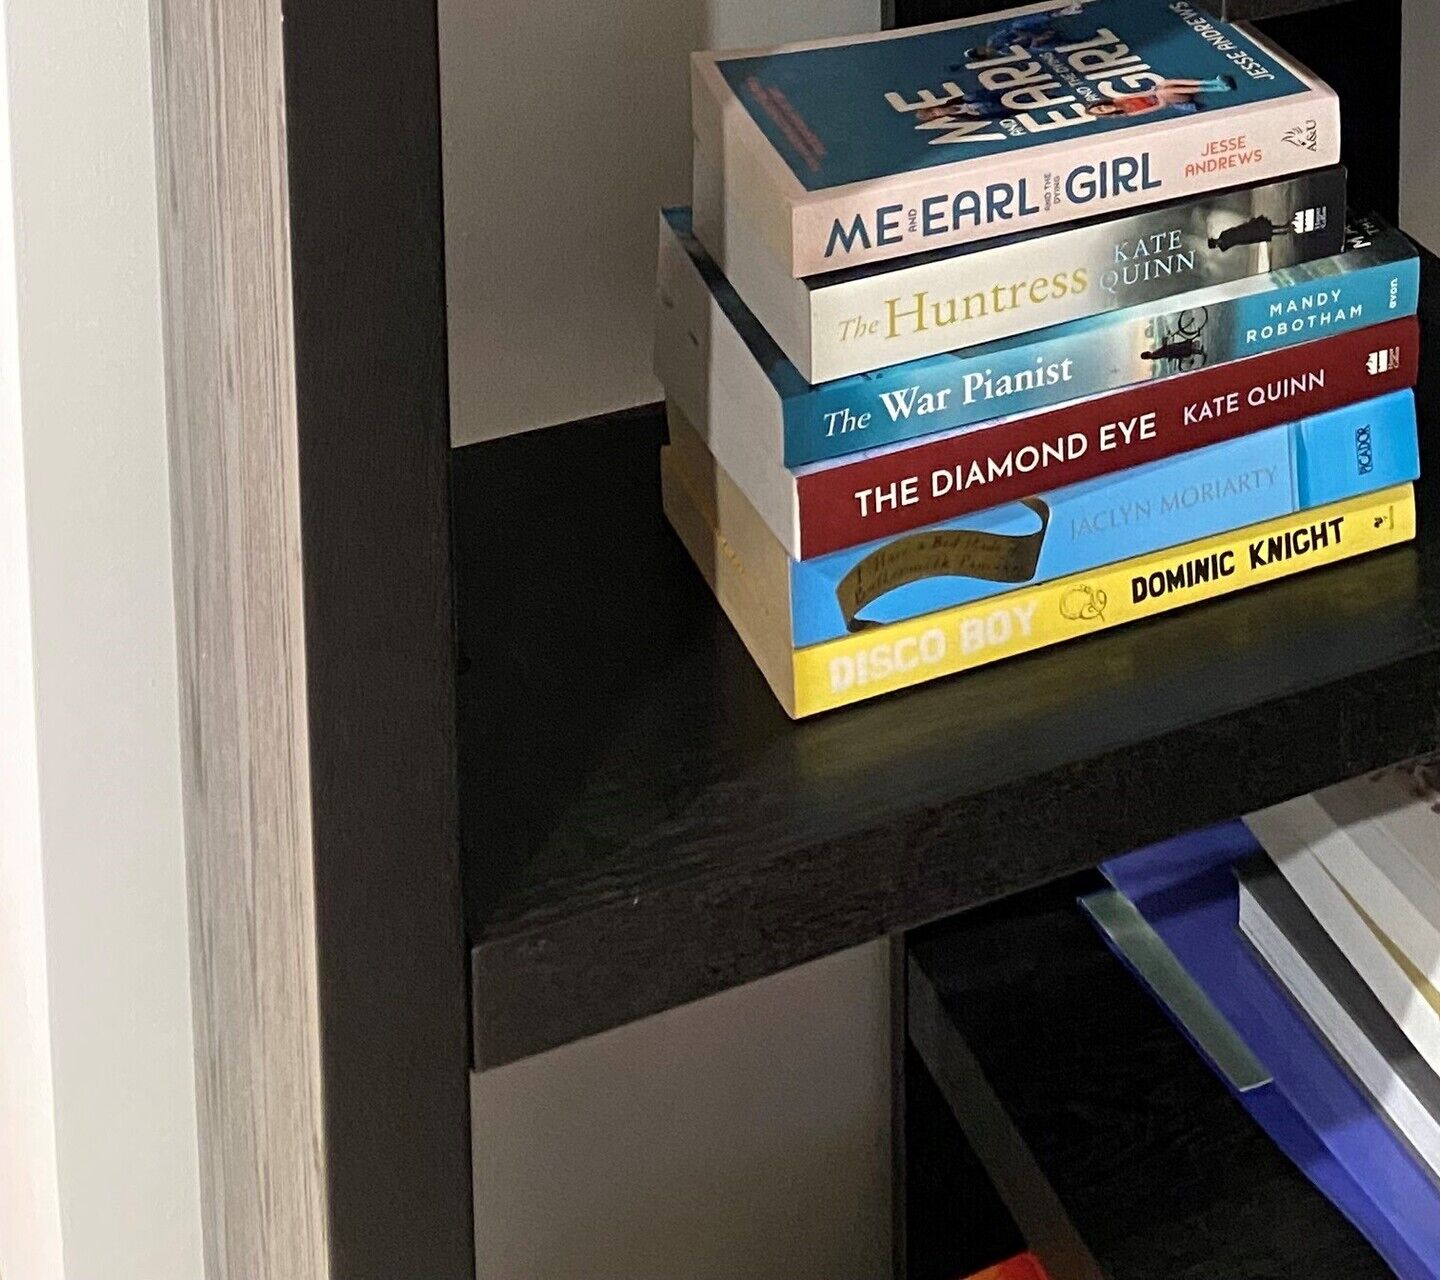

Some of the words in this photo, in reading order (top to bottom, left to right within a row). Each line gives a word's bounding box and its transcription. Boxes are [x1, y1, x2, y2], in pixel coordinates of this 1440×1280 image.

[1168, 0, 1237, 51] ANDREWS
[964, 44, 1097, 132] EARL
[1055, 28, 1165, 99] GIRL
[1225, 48, 1275, 80] JESSE
[884, 81, 1007, 146] ME
[1306, 119, 1317, 152] A&U
[1184, 149, 1264, 178] ANDREWS
[1199, 135, 1247, 158] JESSE
[1053, 175, 1061, 204] DYING
[1065, 152, 1162, 205] GIRL
[824, 203, 904, 258] ME
[907, 206, 918, 233] AND
[921, 175, 1040, 238] EARL
[1100, 249, 1197, 296] QUINN
[1113, 230, 1183, 264] KATE
[838, 315, 879, 343] The
[883, 267, 1088, 340] Huntress
[1269, 289, 1343, 319] MANDY
[1389, 277, 1398, 309] avon
[1246, 304, 1364, 344] ROBOTHAM
[823, 408, 872, 440] The
[878, 387, 951, 426] War
[962, 357, 1073, 407] Pianist
[1183, 395, 1240, 426] KATE
[1246, 368, 1326, 408] QUINN
[854, 476, 920, 518] THE
[931, 433, 1088, 497] DIAMOND
[1100, 412, 1157, 451] EYE
[1356, 424, 1373, 475] PICADOR
[1070, 500, 1150, 540] JACLYN
[1161, 464, 1277, 515] MORIARTY
[1130, 550, 1235, 604] DOMINIC
[1249, 517, 1345, 570] KNIGHT
[829, 628, 946, 696] DISCO
[961, 602, 1037, 652] BOY
